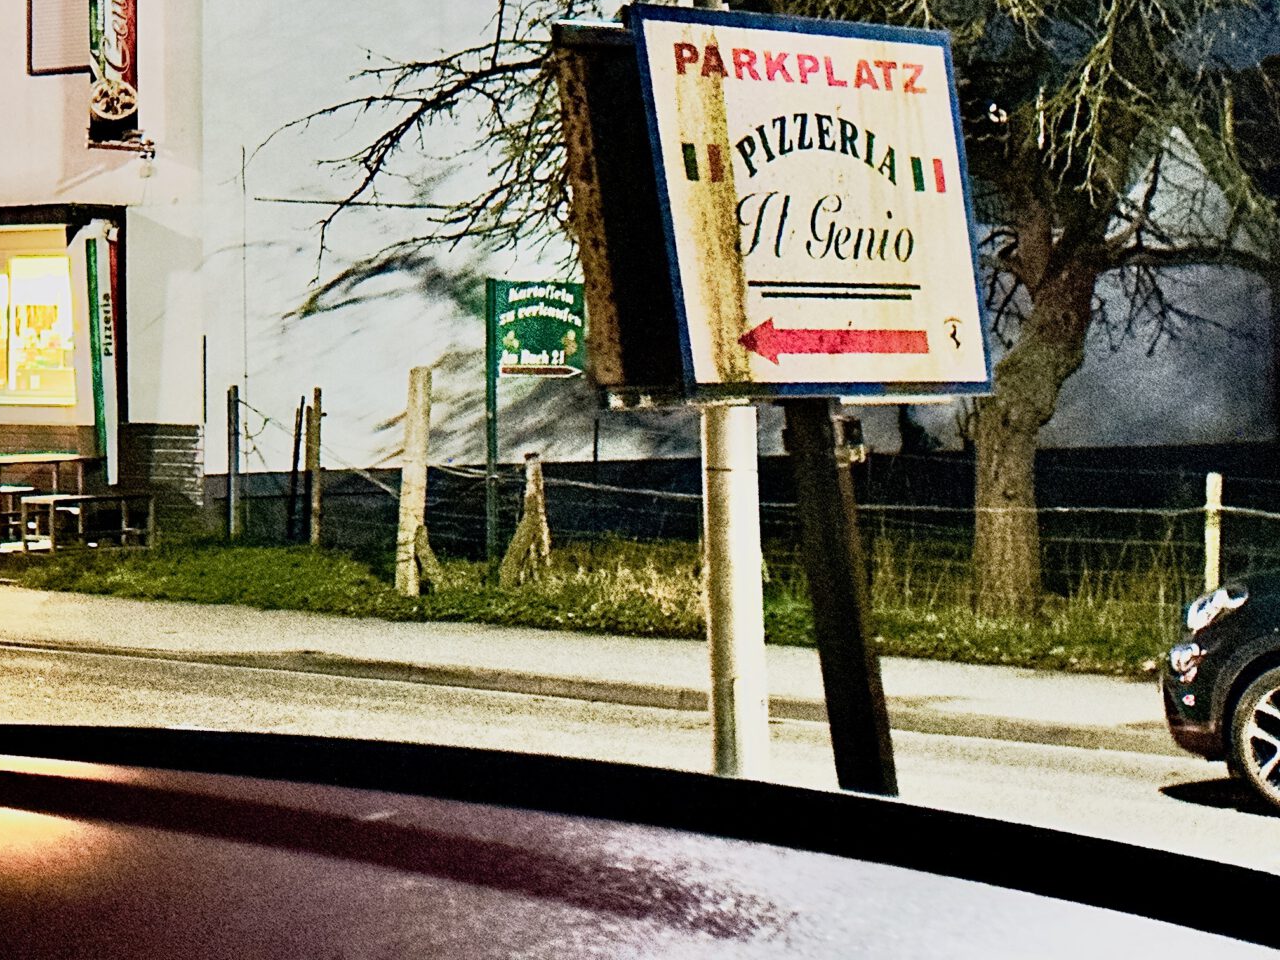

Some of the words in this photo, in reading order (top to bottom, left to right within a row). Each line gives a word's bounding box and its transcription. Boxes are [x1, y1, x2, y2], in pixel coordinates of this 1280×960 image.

[673, 42, 927, 94] PARKPLATZ
[735, 113, 897, 186] PIZZERIA
[735, 191, 790, 258] Il
[806, 194, 914, 262] Genio
[101, 293, 113, 356] Pizzeria
